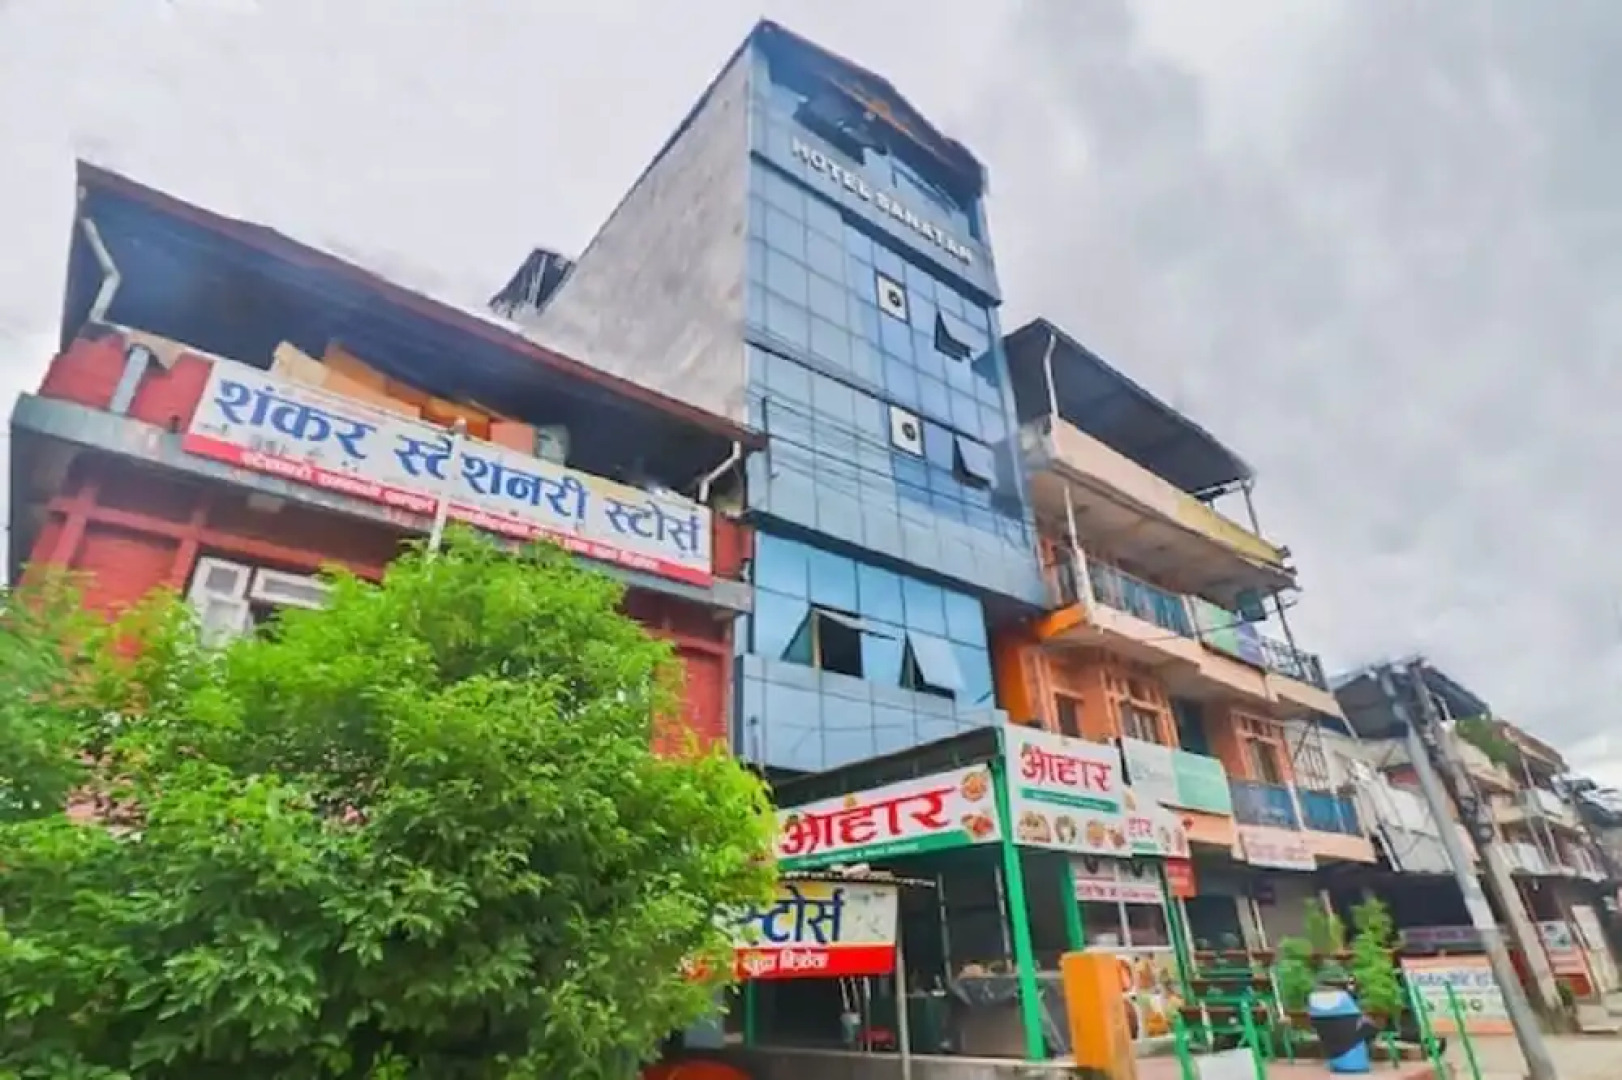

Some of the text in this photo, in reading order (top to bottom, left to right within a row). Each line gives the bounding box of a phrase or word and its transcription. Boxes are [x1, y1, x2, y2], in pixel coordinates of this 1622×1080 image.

[792, 136, 869, 201] HOTEL
[214, 378, 378, 459] शंकर
[394, 433, 589, 518] स्टेशनरी
[603, 497, 699, 551] स्टोर्स
[1021, 746, 1112, 792] आहार
[780, 786, 956, 854] आहार
